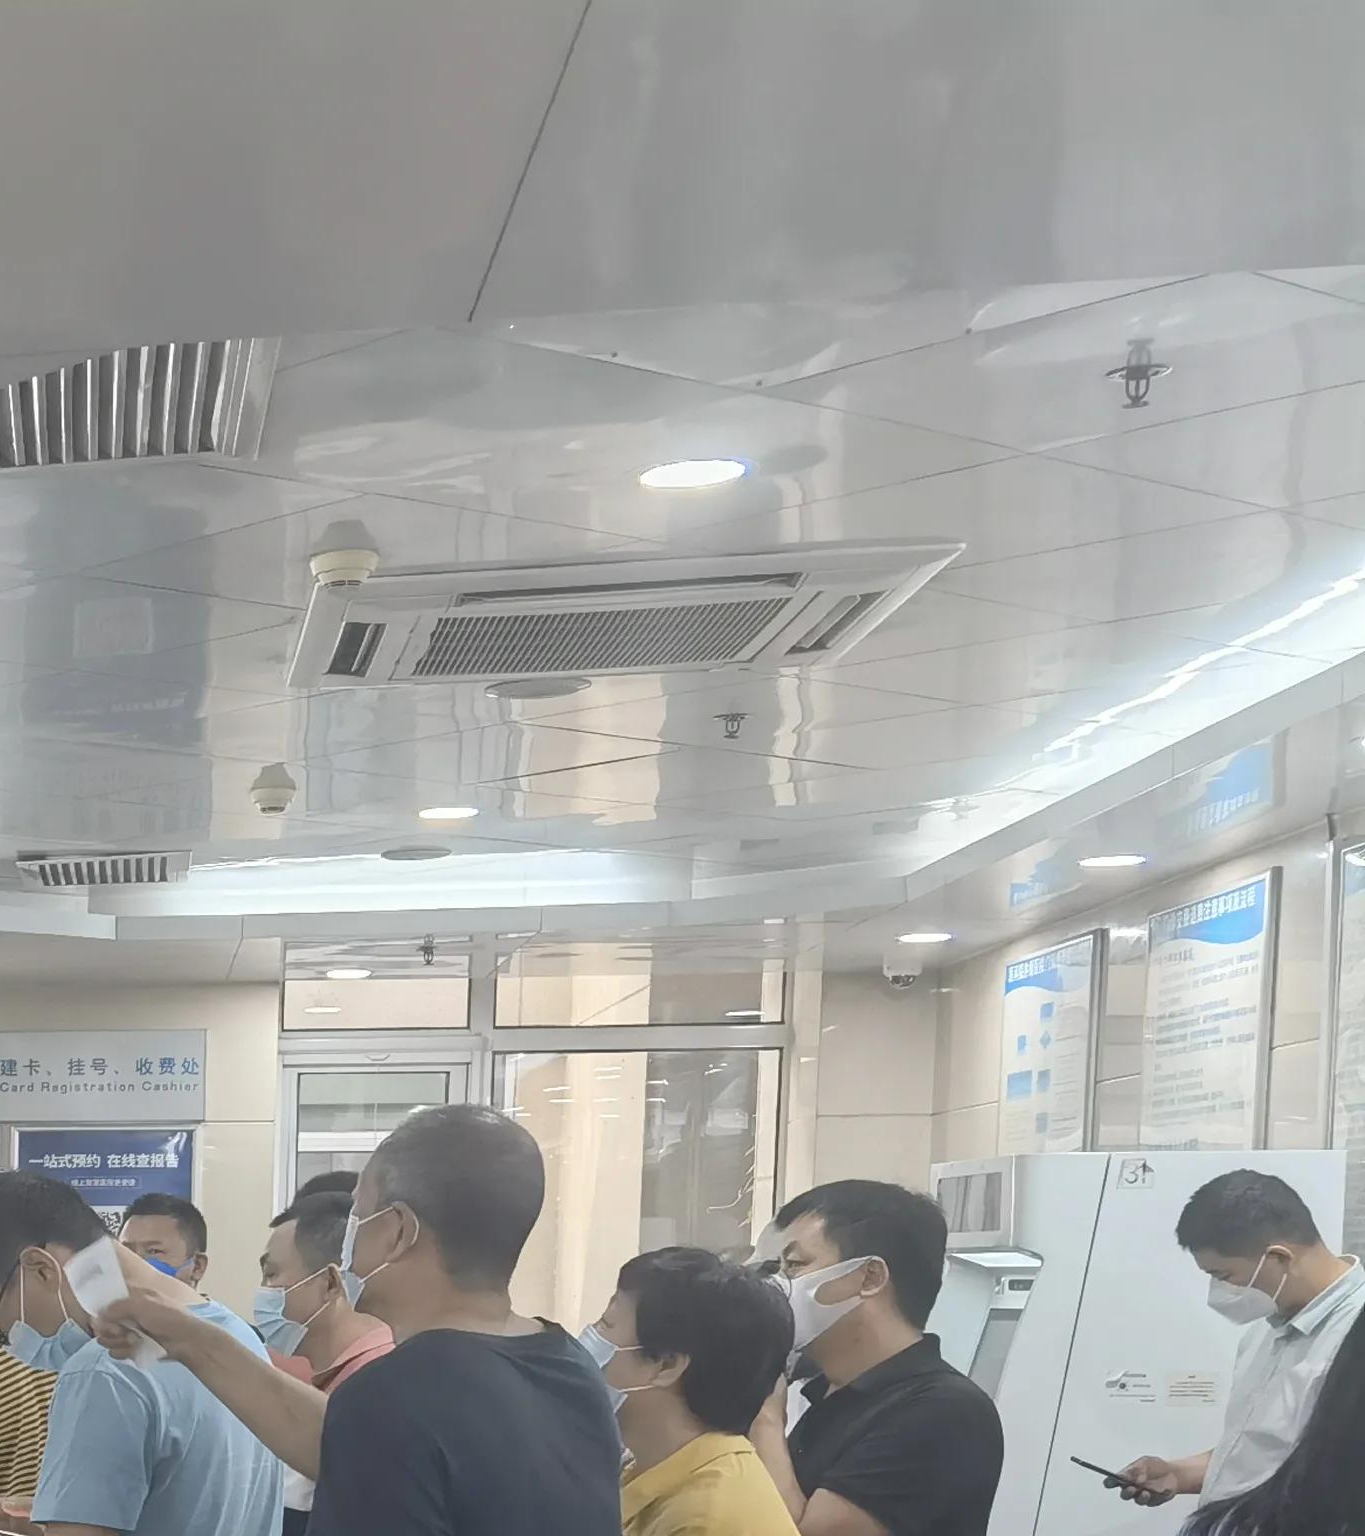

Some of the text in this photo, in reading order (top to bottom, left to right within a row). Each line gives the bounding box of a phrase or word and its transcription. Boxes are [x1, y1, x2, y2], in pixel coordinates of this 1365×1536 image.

[0, 1057, 200, 1077] 建卡、挂号、收费处
[0, 1081, 34, 1093] Card
[142, 1080, 200, 1092] Cashier
[28, 1152, 180, 1169] 一站式预约 在线查报告
